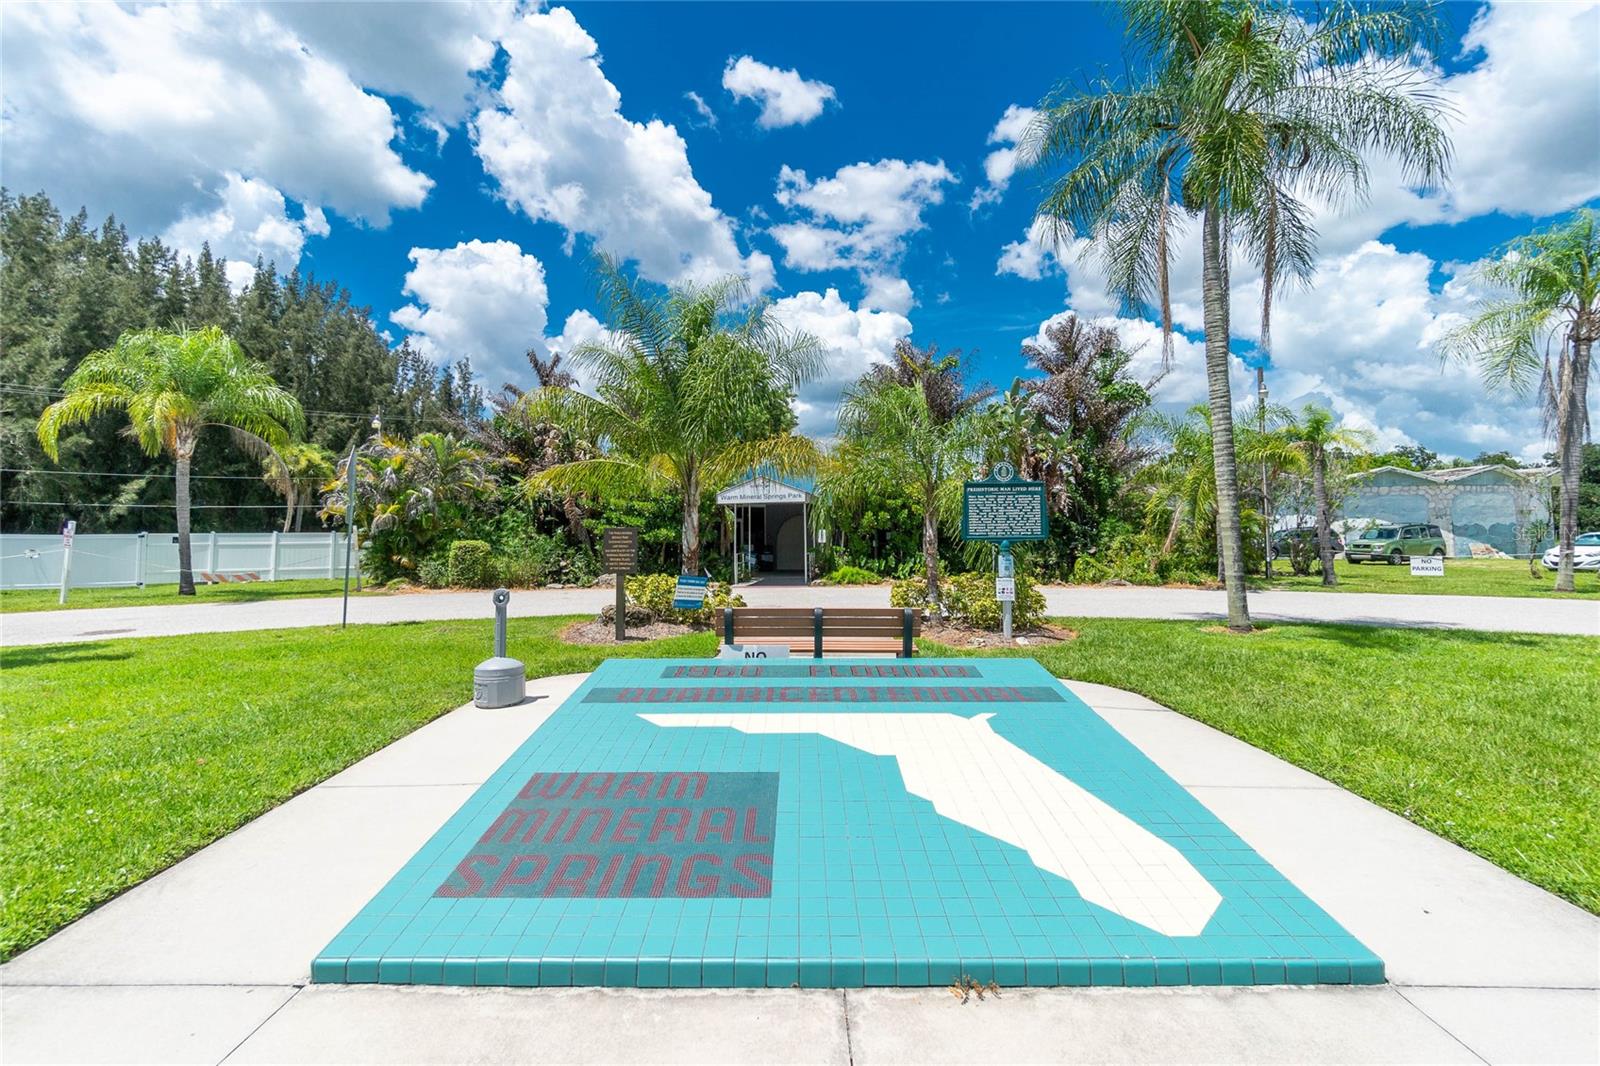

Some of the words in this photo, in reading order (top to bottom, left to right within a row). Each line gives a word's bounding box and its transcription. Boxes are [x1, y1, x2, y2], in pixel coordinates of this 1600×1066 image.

[763, 493, 787, 501] Springs
[673, 665, 764, 678] 1960
[809, 665, 970, 678] FLORIDA
[615, 686, 1036, 704] QUADRICENTENNIAL
[518, 772, 710, 800] WARM
[479, 807, 770, 845] MINERAL
[436, 854, 773, 899] SPRINGS
